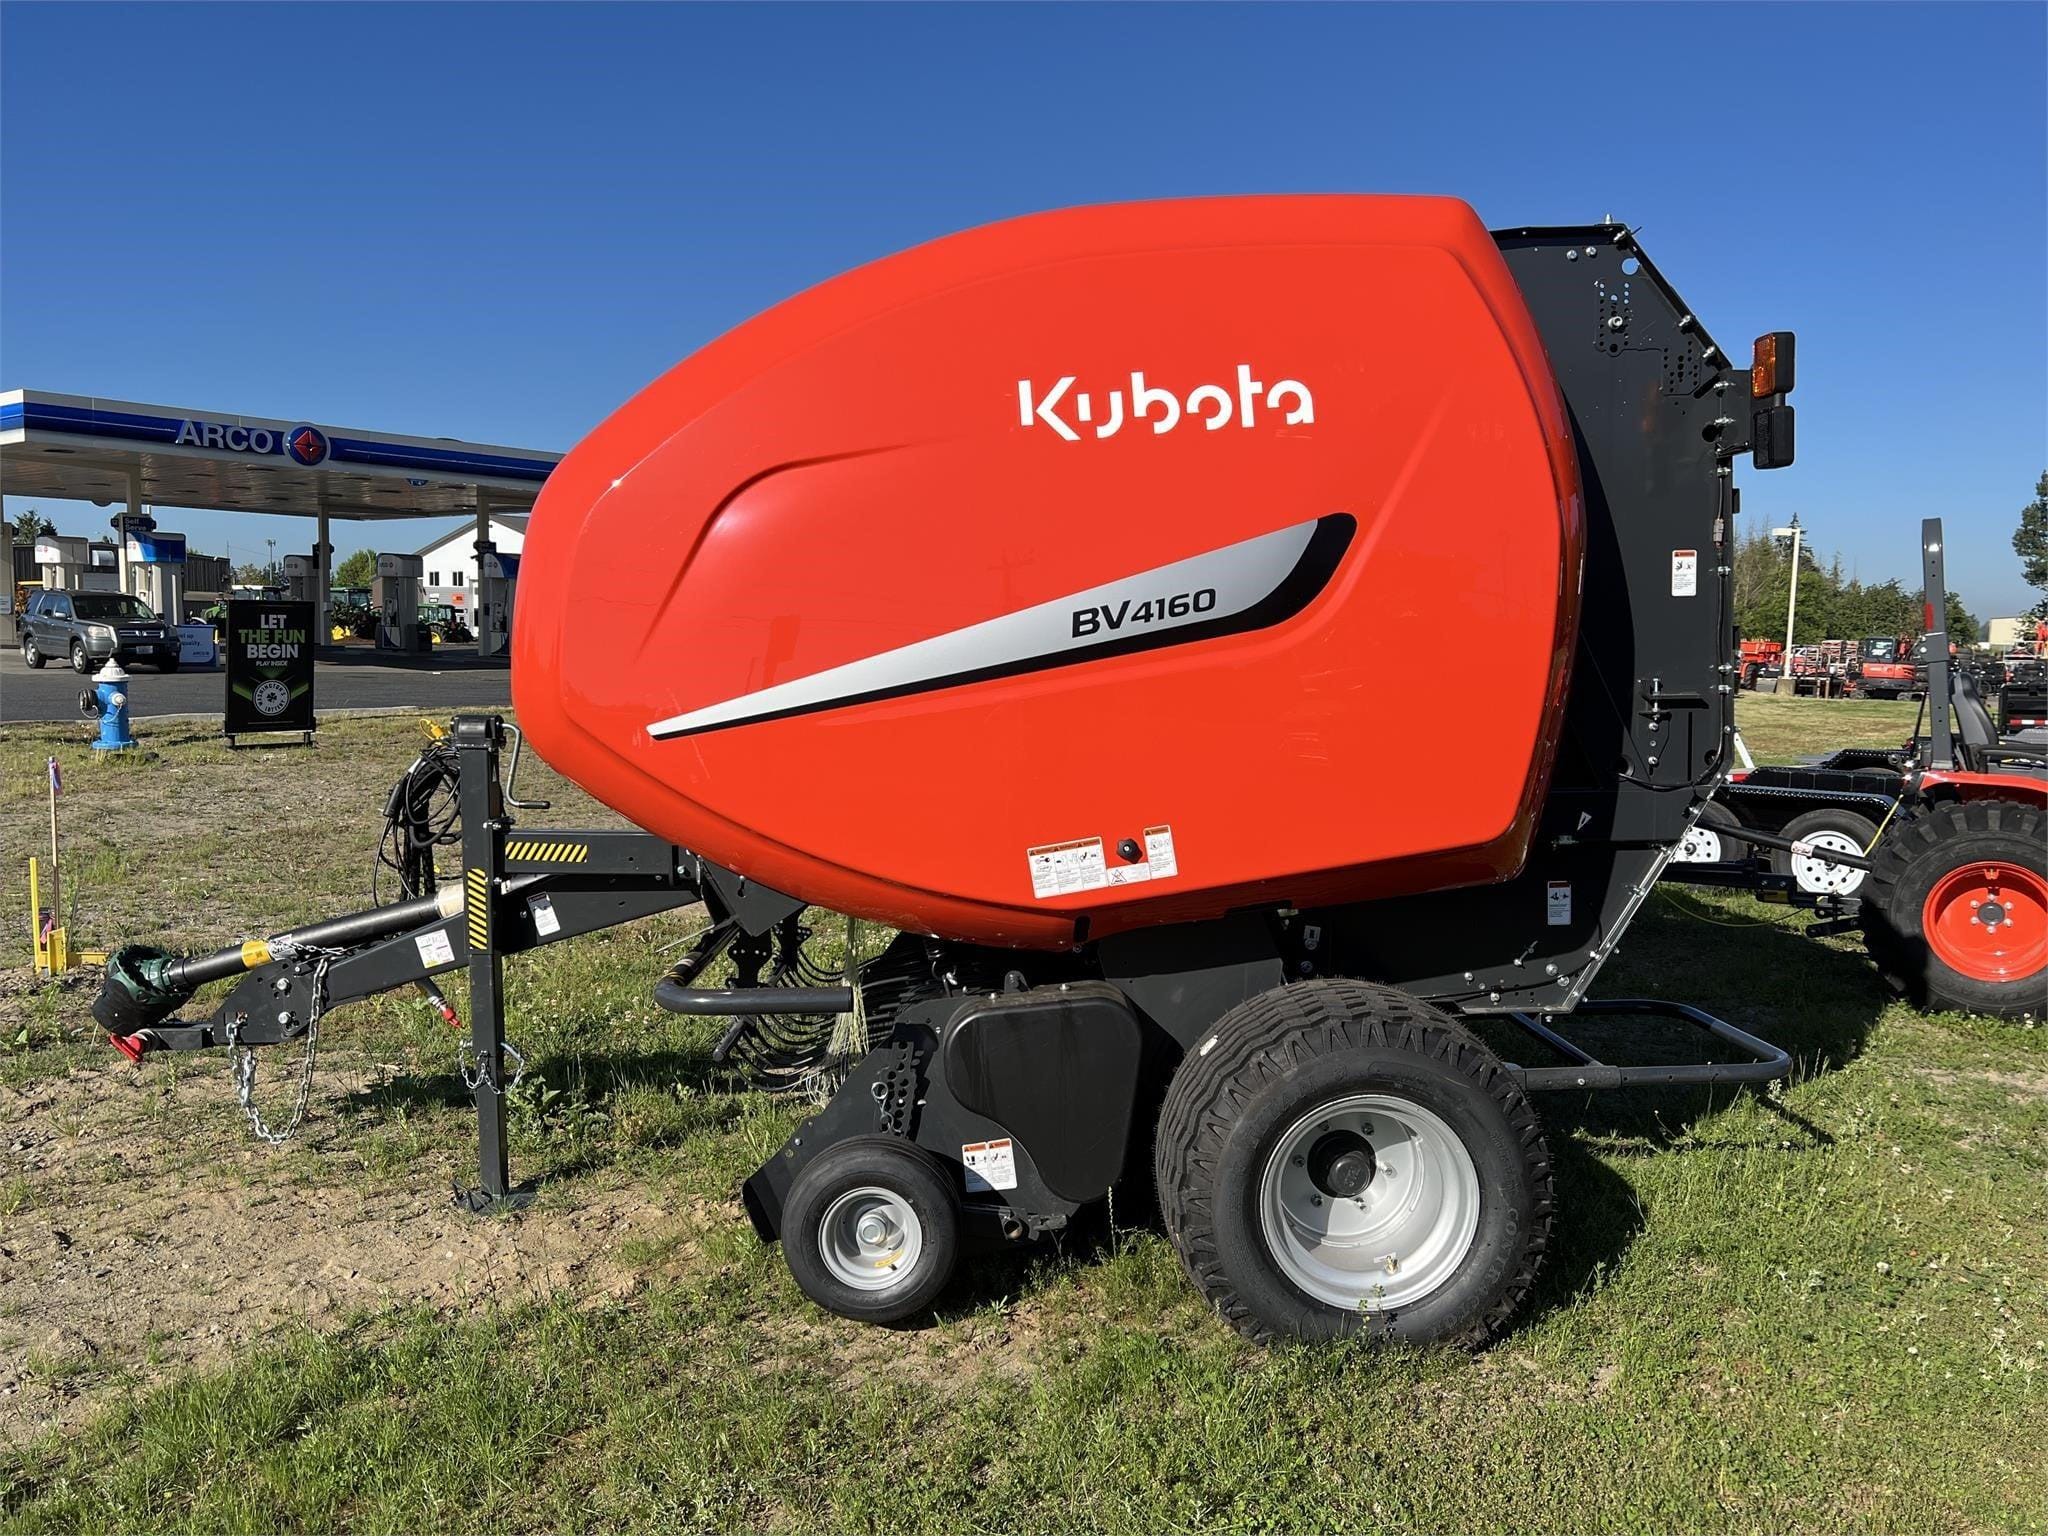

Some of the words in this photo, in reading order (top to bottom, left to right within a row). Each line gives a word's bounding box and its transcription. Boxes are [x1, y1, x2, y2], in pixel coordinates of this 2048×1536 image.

[1018, 363, 1315, 441] Kubota
[175, 419, 274, 454] ARCO
[124, 517, 140, 525] Self
[124, 524, 147, 532] Serve
[1072, 588, 1216, 638] BV4160
[260, 614, 287, 629] LET
[238, 629, 270, 644] THE
[274, 629, 306, 644] FUN
[247, 644, 299, 659] BEGIN
